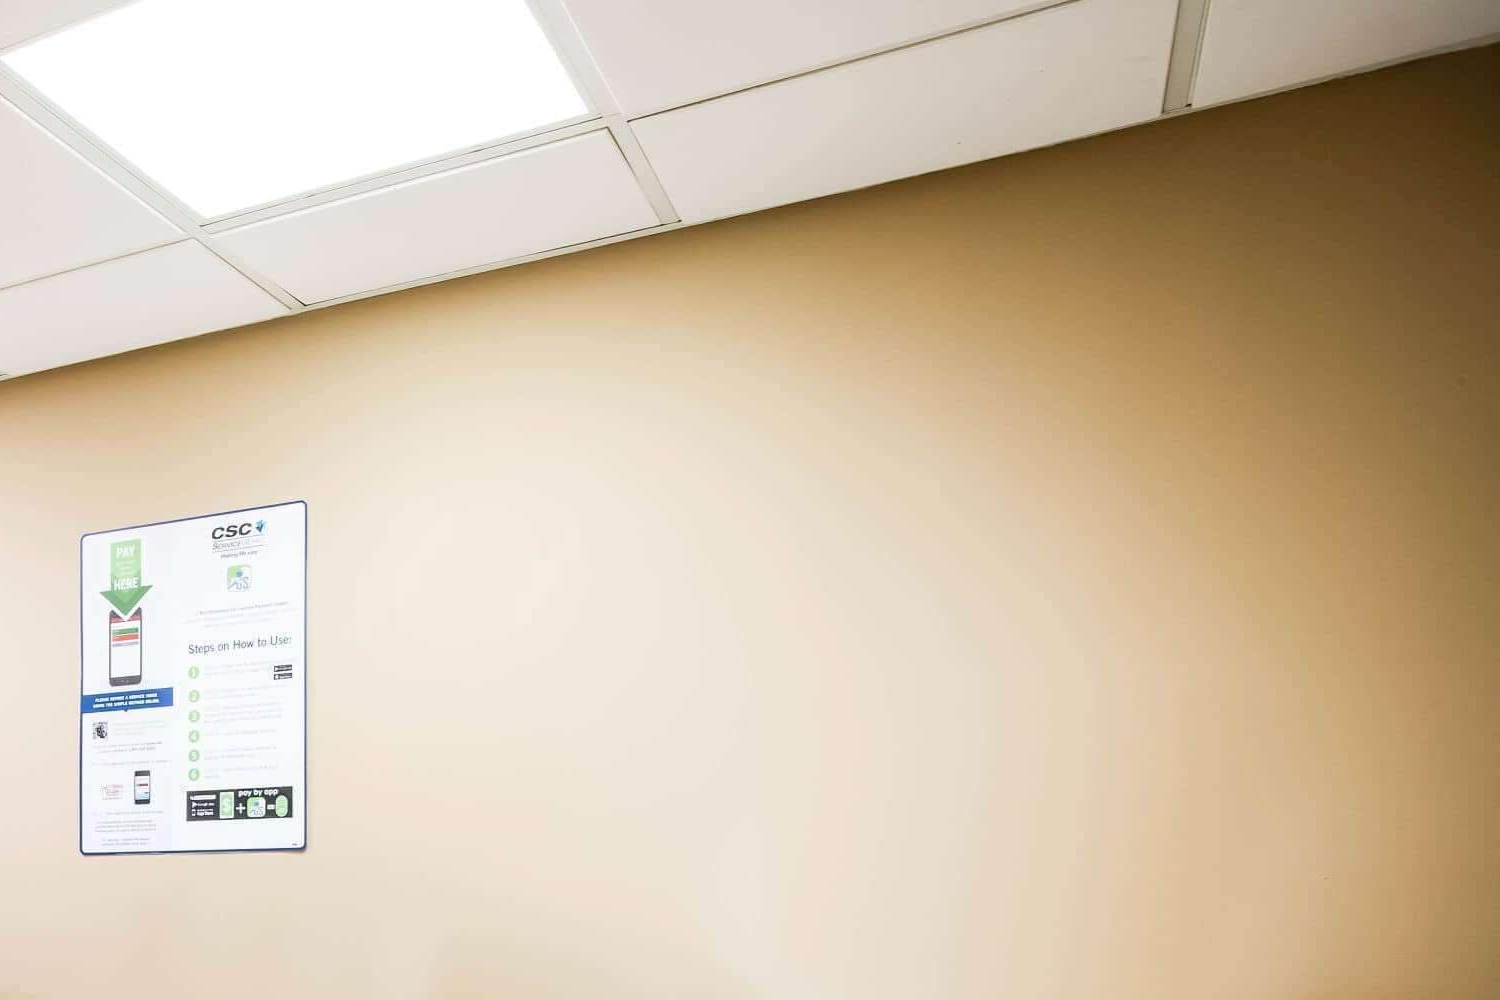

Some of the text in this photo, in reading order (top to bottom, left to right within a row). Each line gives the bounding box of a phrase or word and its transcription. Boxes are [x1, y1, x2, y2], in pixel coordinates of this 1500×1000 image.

[211, 522, 252, 540] CSC
[116, 543, 136, 559] PAY
[113, 576, 139, 591] HERE
[188, 634, 293, 656] Steps on How to Use:
[238, 790, 253, 798] pay
[263, 788, 279, 797] app
